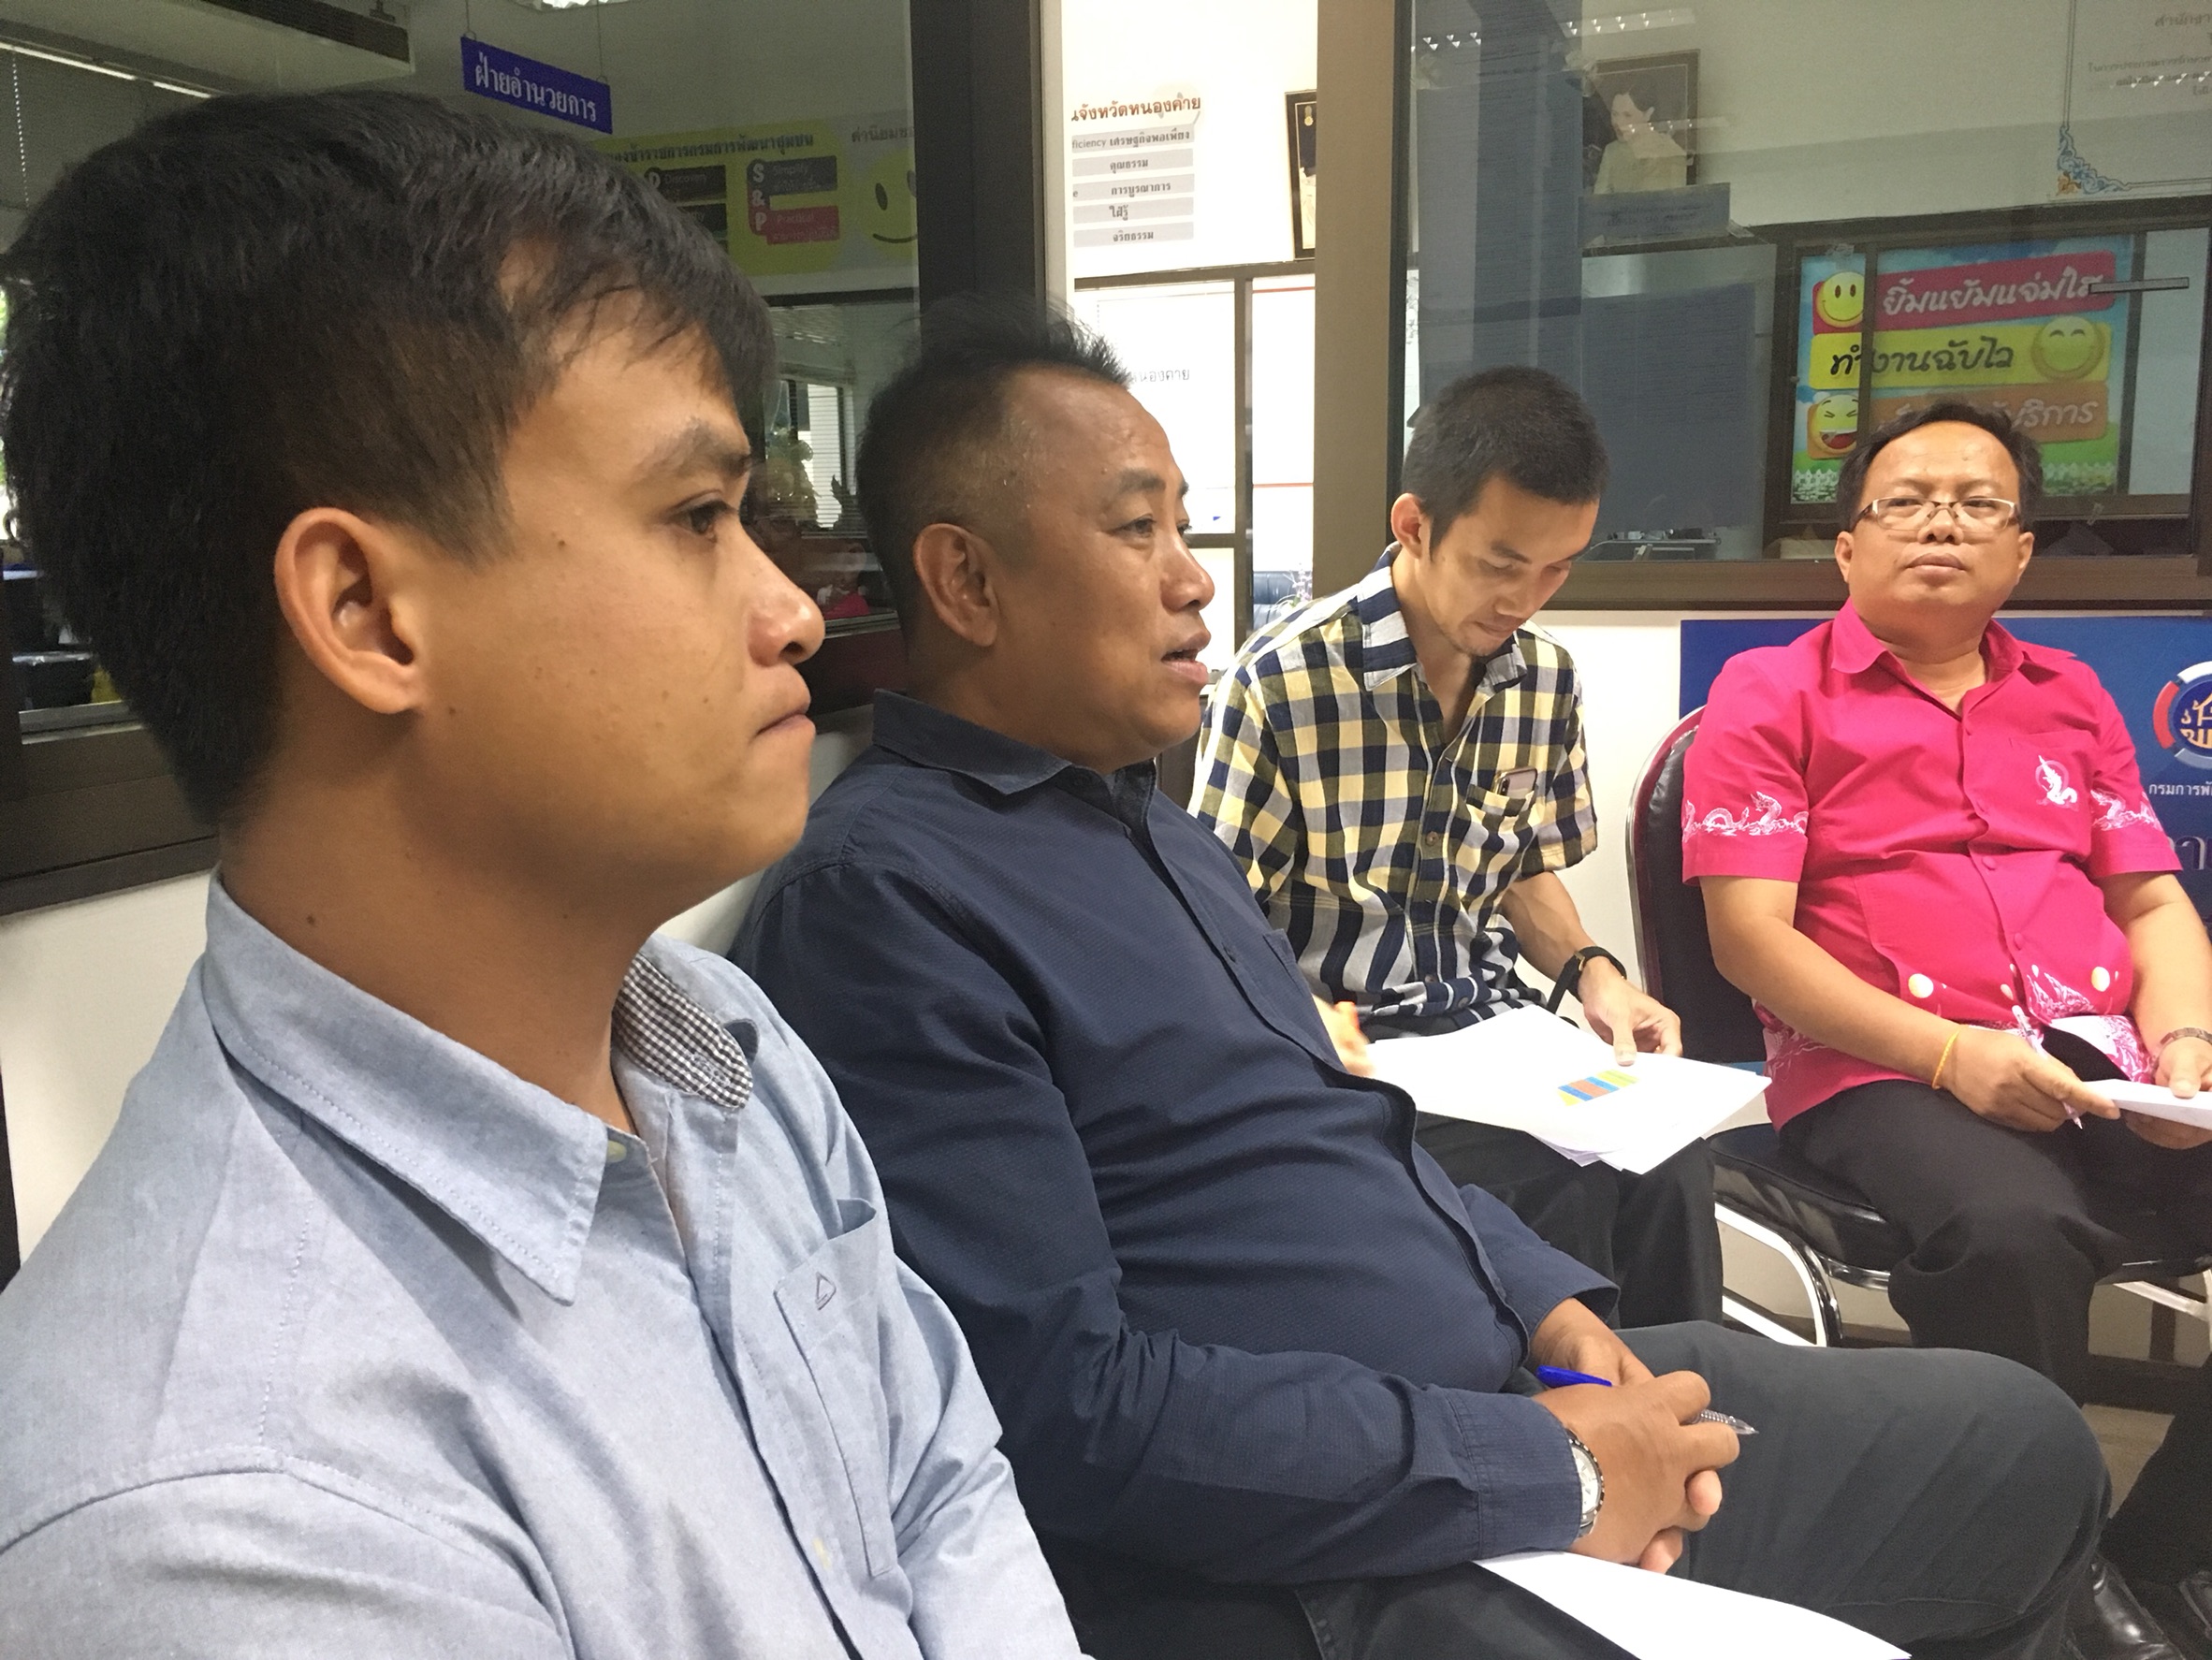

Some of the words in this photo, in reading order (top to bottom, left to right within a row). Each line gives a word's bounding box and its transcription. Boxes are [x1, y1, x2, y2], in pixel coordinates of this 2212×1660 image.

[474, 51, 597, 123] ฝ่ายอำนวยการ
[1109, 158, 1149, 175] คุณธรรม
[2148, 780, 2212, 796] กรมการพั
